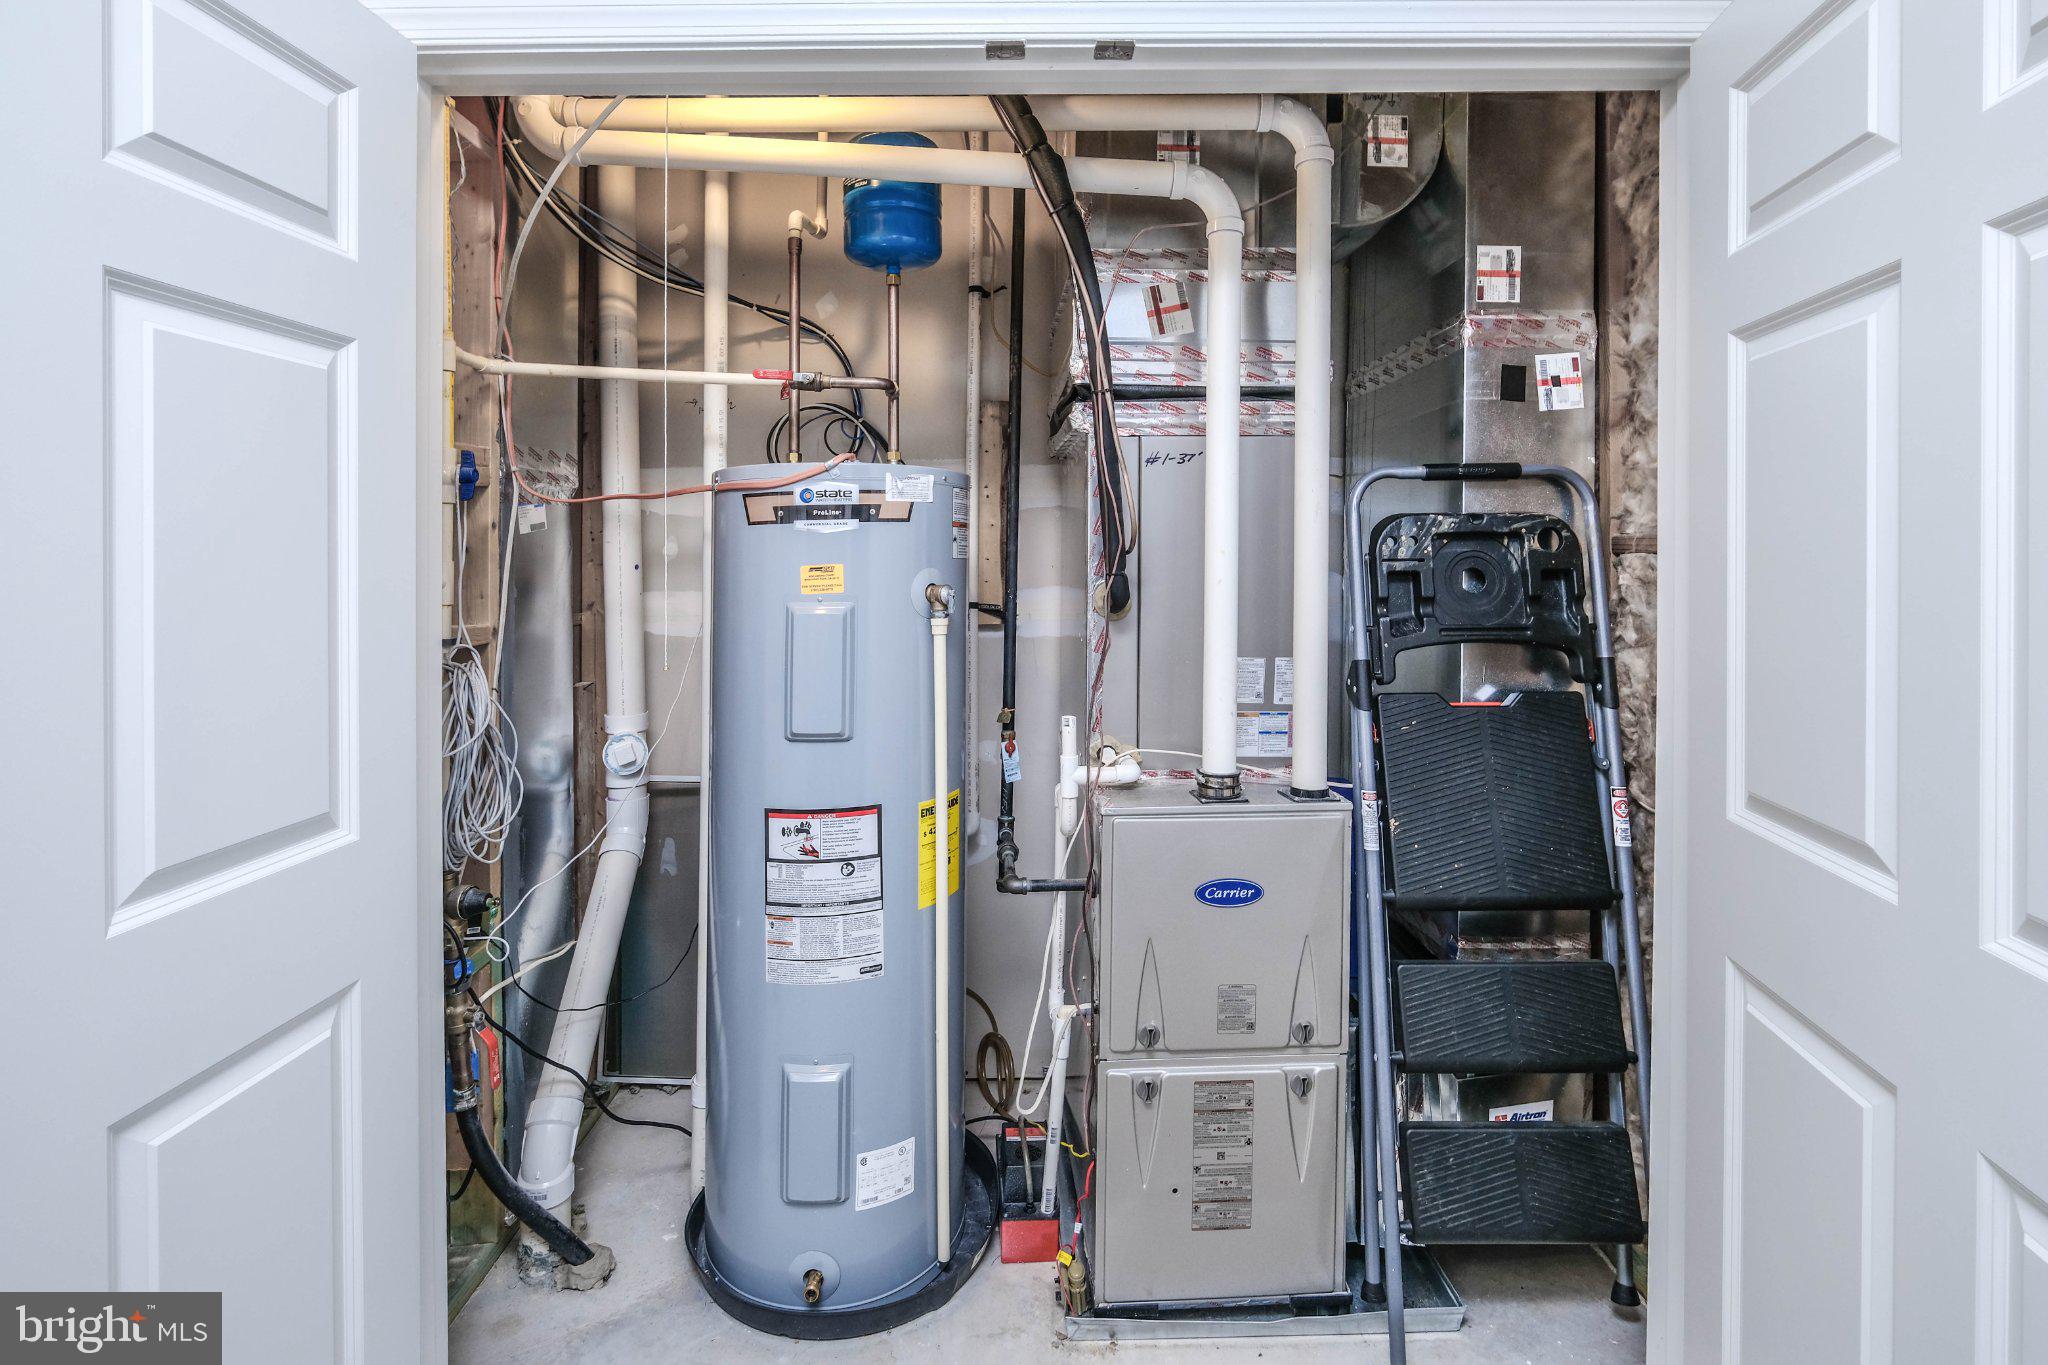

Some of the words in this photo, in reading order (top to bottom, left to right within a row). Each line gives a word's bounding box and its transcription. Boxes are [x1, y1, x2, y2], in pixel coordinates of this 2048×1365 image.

[815, 489, 853, 499] state
[1205, 887, 1255, 899] Carrier
[1510, 1111, 1546, 1121] Airtron
